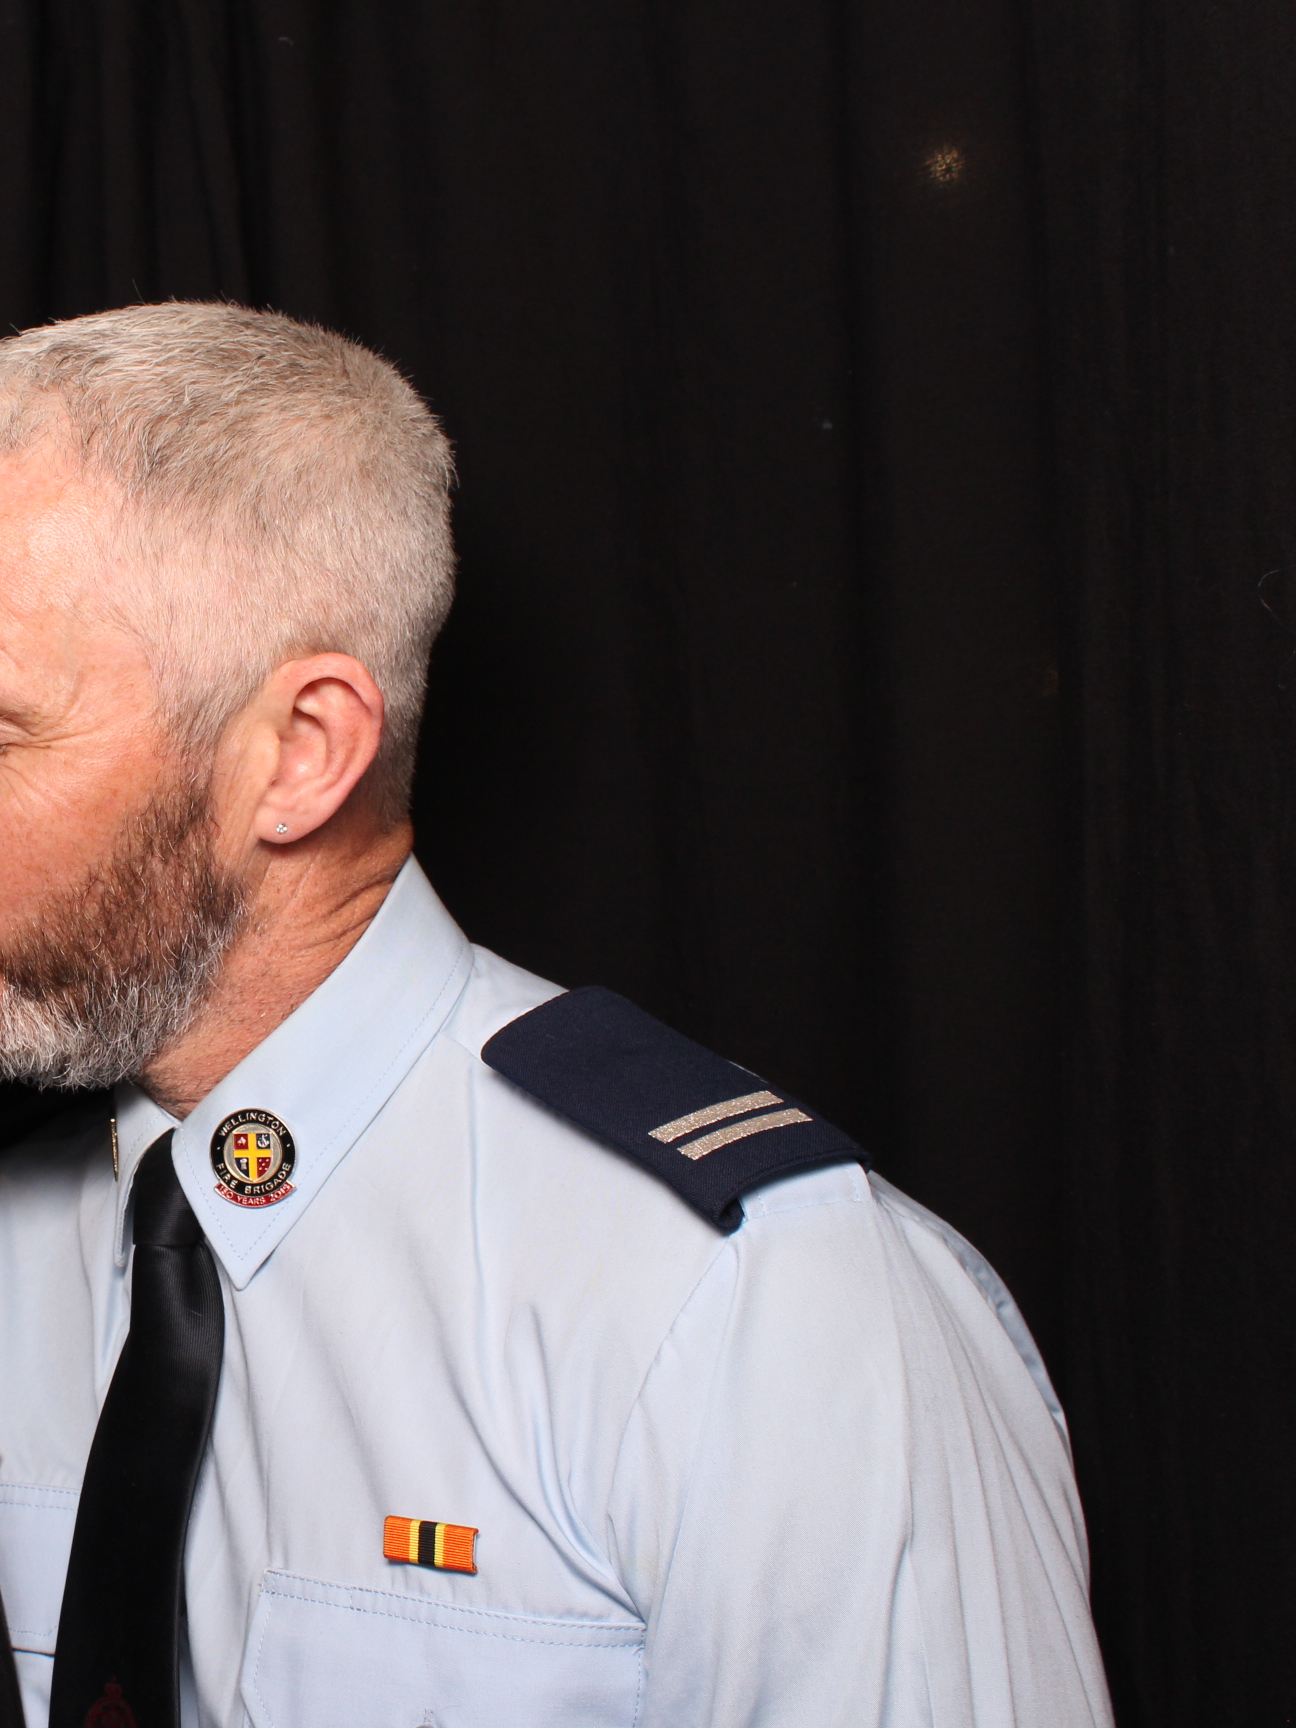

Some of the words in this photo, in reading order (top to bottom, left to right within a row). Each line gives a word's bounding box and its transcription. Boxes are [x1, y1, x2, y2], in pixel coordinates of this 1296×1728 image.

[219, 1112, 287, 1137] WELLINGTON
[216, 1163, 239, 1189] FIRE
[245, 1162, 292, 1194] BRIGADE
[237, 1196, 266, 1205] YEARS
[269, 1183, 291, 1202] 2019
